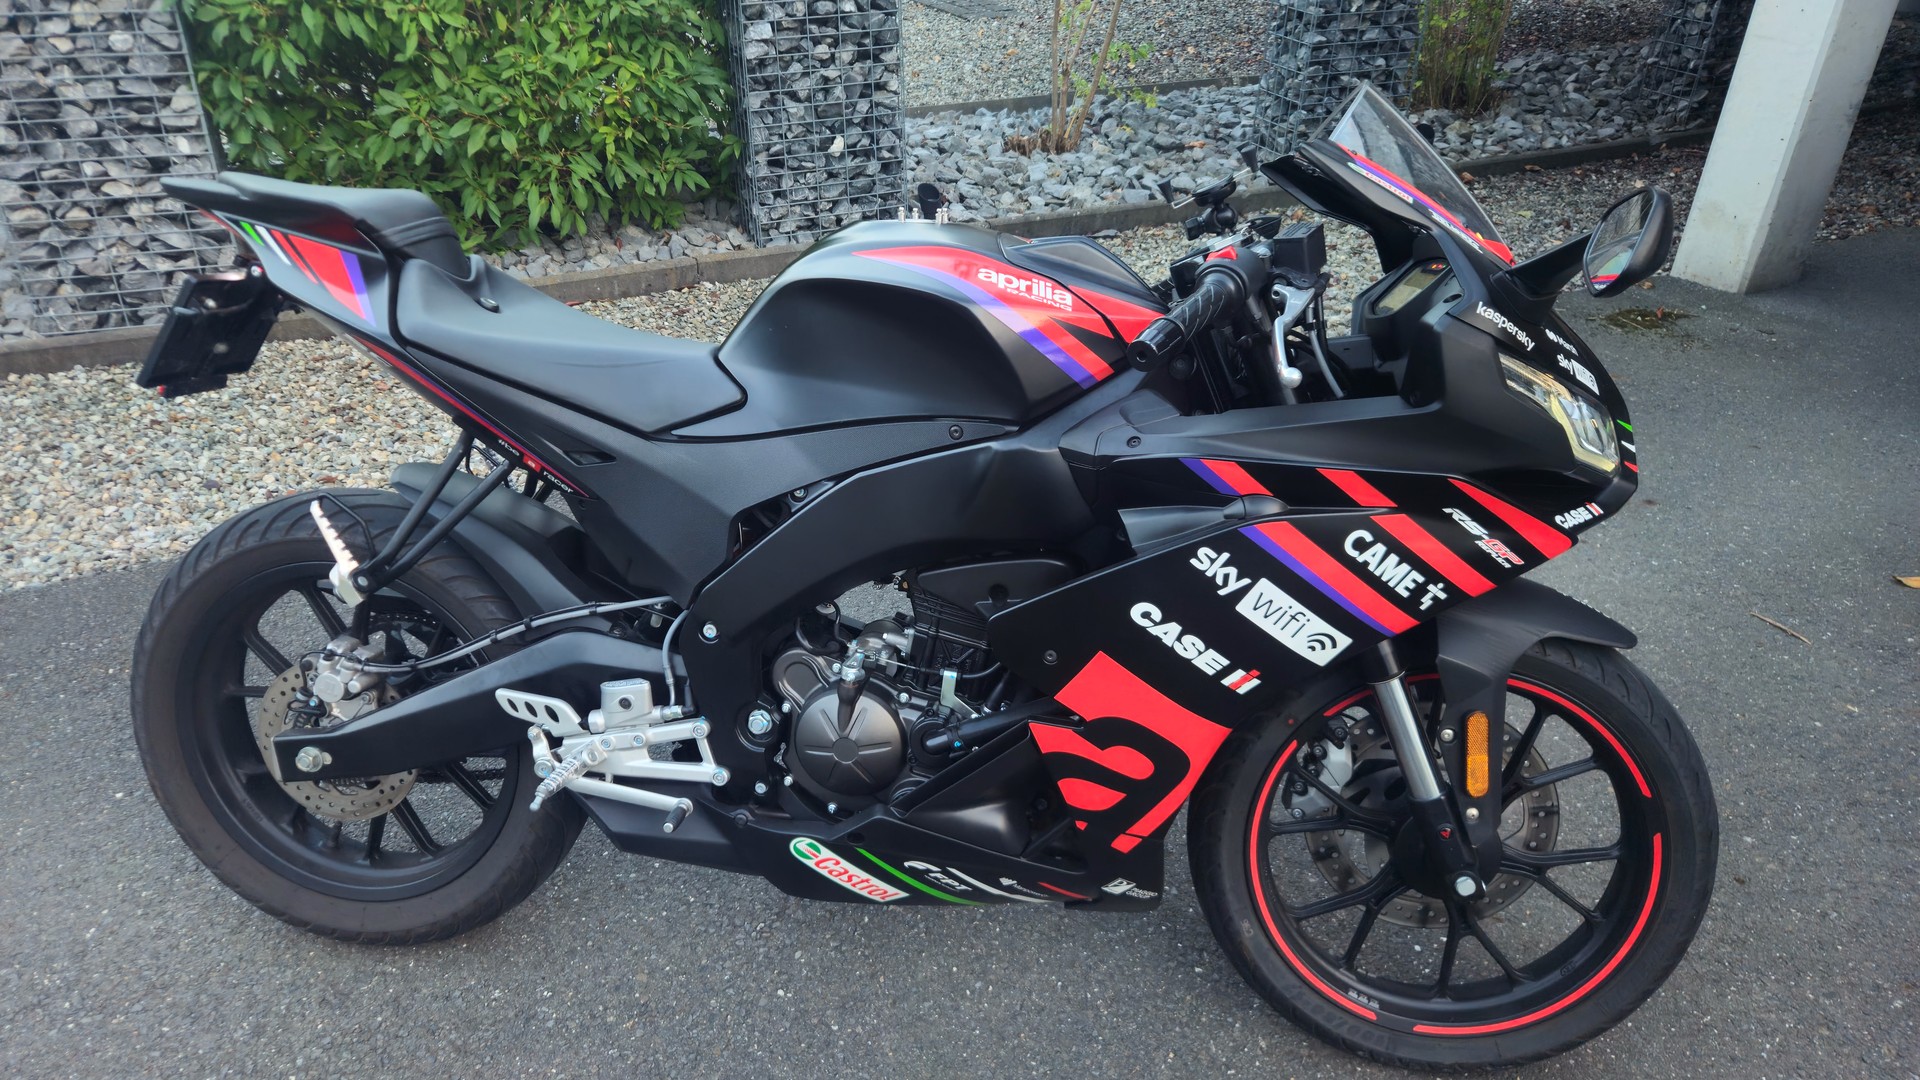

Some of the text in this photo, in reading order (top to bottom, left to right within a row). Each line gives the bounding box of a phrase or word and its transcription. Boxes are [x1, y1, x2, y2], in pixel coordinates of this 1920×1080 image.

[977, 268, 1072, 306] aprilia
[1006, 288, 1073, 312] RACING
[1476, 301, 1535, 351] kaspersky
[1556, 354, 1574, 375] sky
[543, 471, 574, 493] racer
[1554, 507, 1593, 529] CASE
[1344, 529, 1425, 598] CAME
[1474, 540, 1513, 569] REPLICA
[1189, 547, 1311, 639] sky wifi
[1130, 602, 1231, 677] CASE
[814, 857, 902, 900] Castrol
[928, 872, 973, 891] FPT
